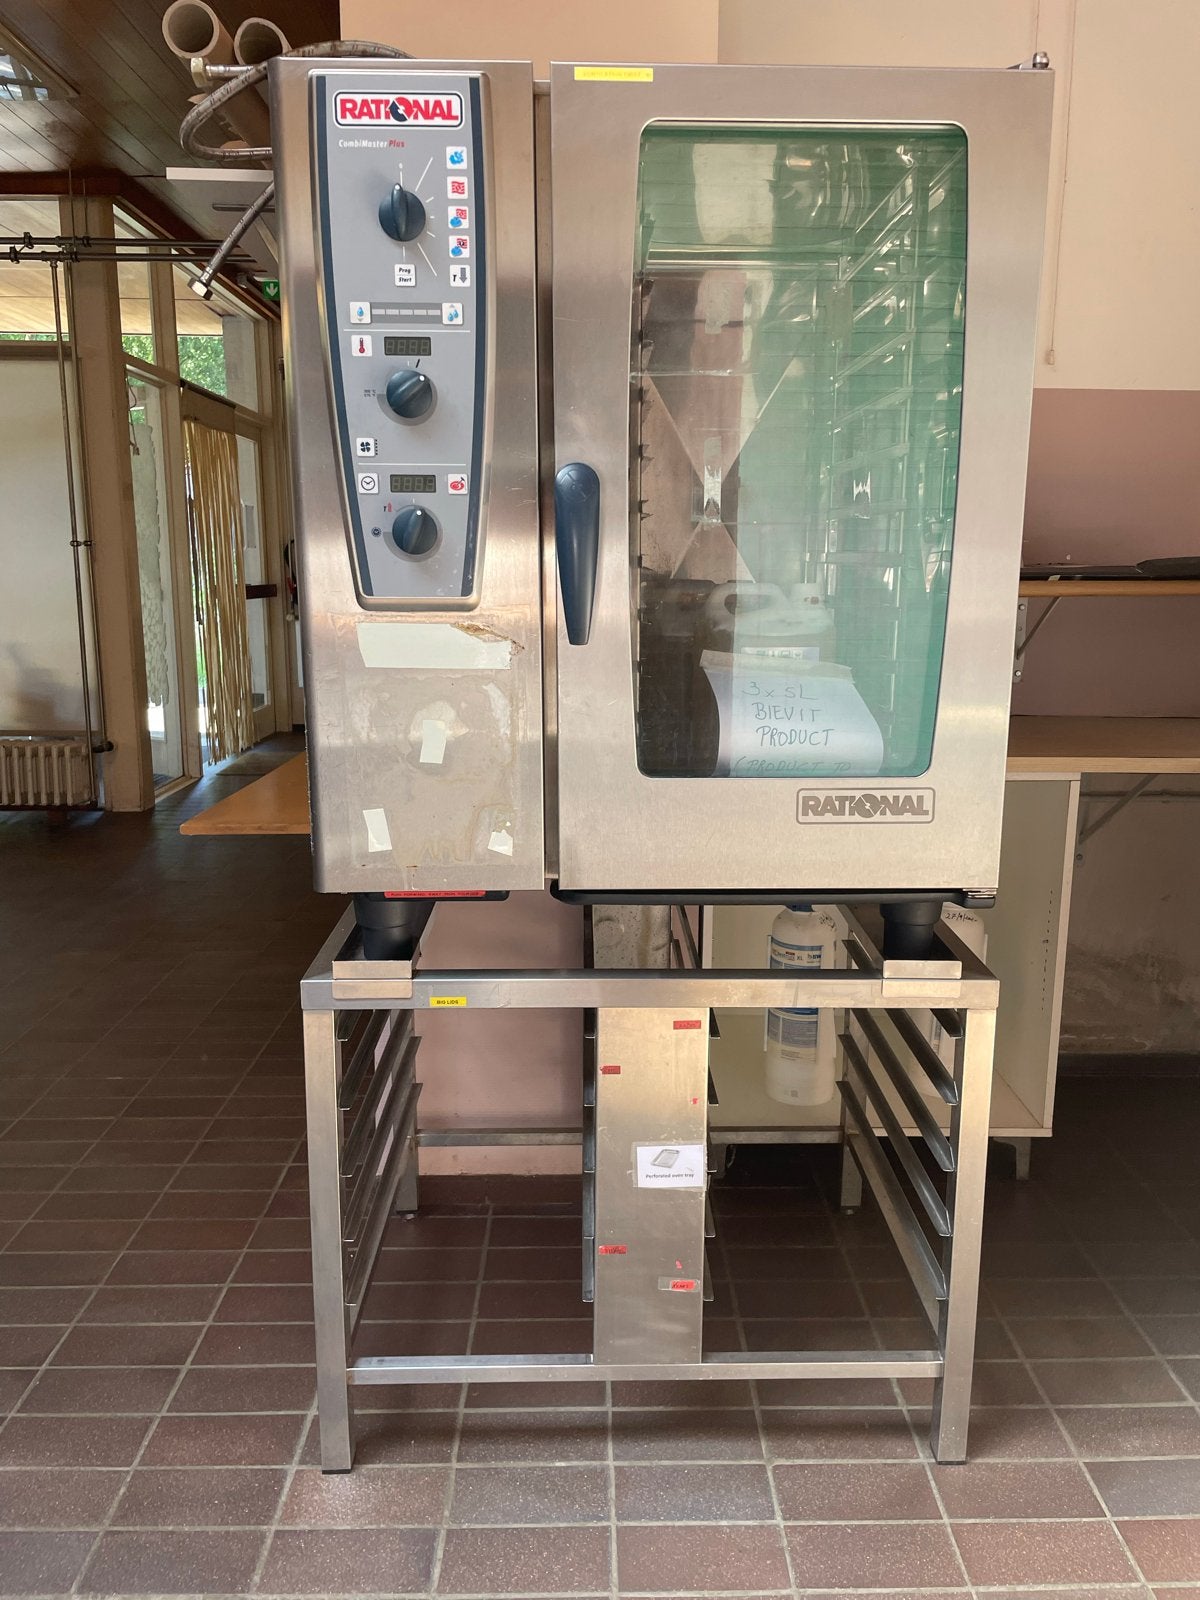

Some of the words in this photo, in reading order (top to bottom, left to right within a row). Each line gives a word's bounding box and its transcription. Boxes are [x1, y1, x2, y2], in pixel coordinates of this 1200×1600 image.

[340, 97, 459, 122] RATIONAL
[338, 139, 388, 148] CombiMaster
[388, 139, 405, 148] Plus
[755, 725, 835, 747] PRODUCT
[801, 793, 930, 819] RATIONAL
